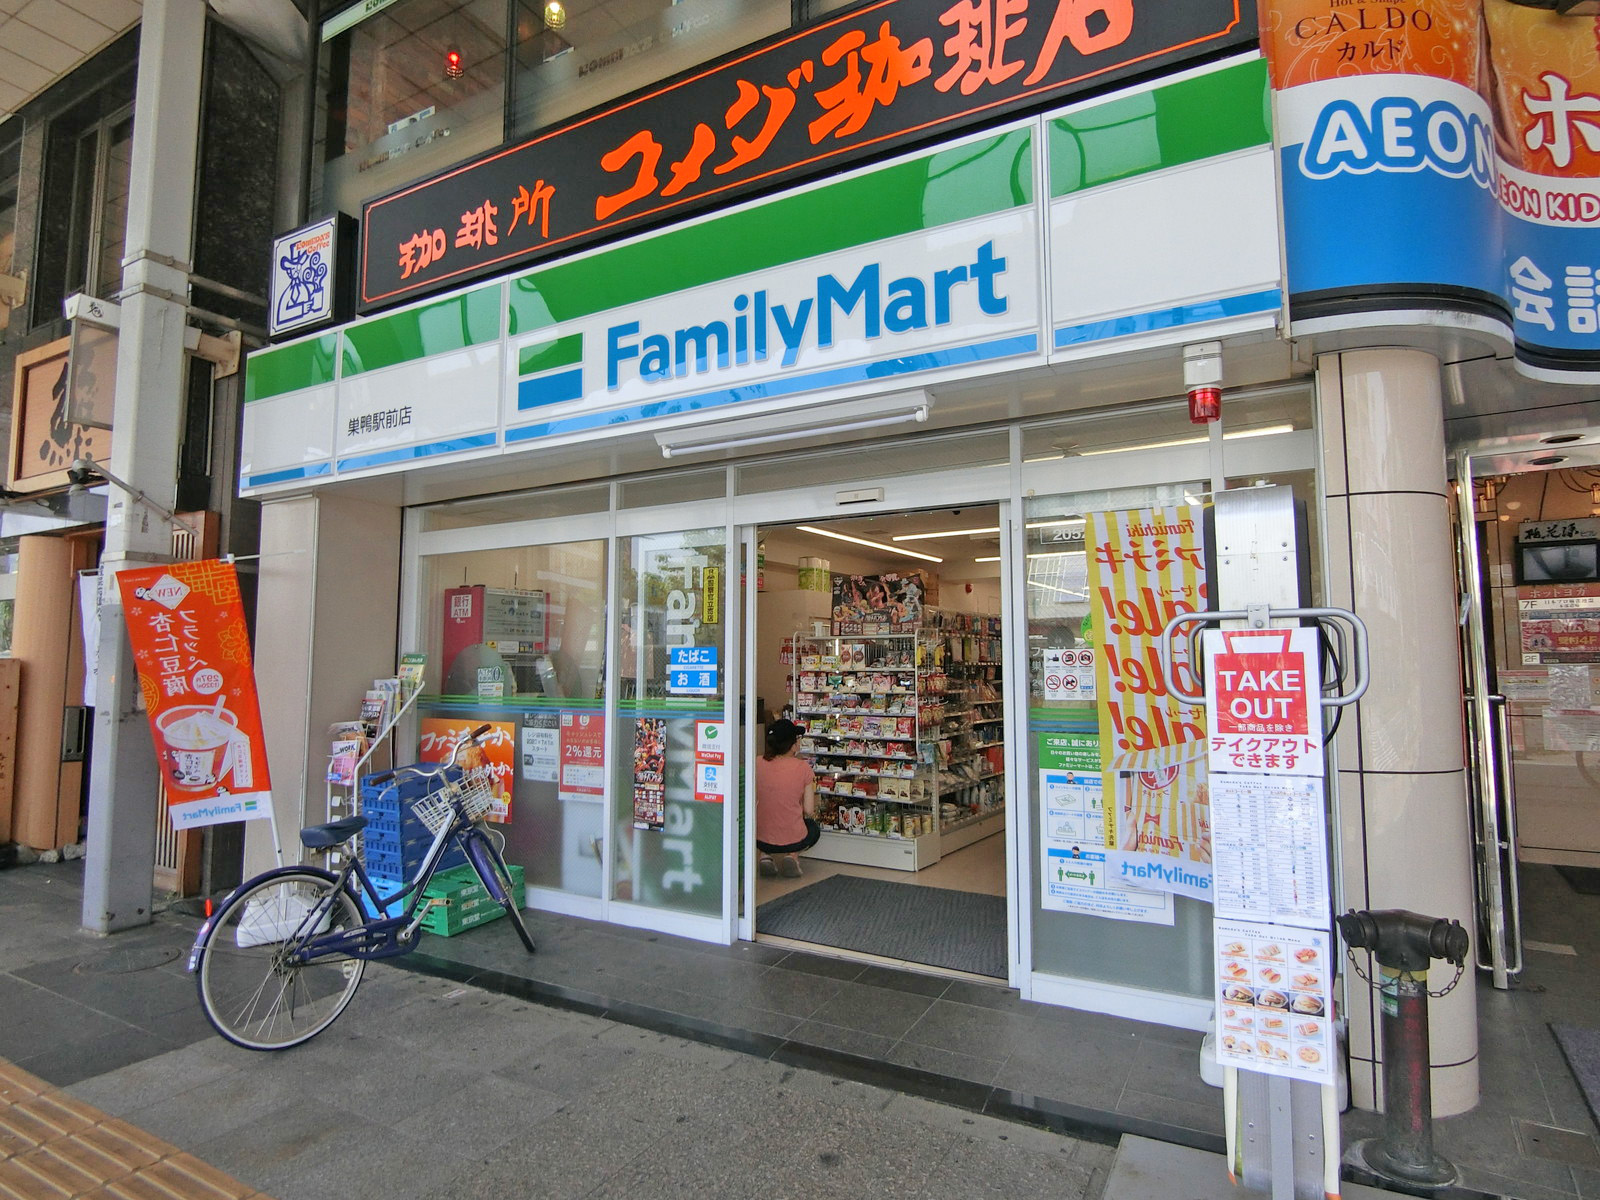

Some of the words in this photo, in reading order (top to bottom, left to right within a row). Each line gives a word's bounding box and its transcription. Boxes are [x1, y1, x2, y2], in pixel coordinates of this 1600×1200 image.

[1295, 7, 1432, 39] CALDO
[1337, 38, 1403, 62] カルド
[1304, 98, 1497, 192] AEON
[398, 179, 557, 280] 珈琲所
[605, 239, 1010, 392] FamilyMart
[346, 404, 413, 437] 巣鴨駅前店
[453, 608, 469, 617] ATM
[1522, 600, 1538, 609] 7F
[678, 649, 710, 663] たばこ
[1525, 655, 1537, 663] 2F
[1218, 669, 1301, 692] TAKE
[1230, 697, 1293, 719] OUT
[1229, 723, 1294, 733] 一部商品を除き
[565, 744, 602, 758] 2%還元
[1211, 736, 1317, 754] テイクアウト
[1228, 752, 1300, 770] できます
